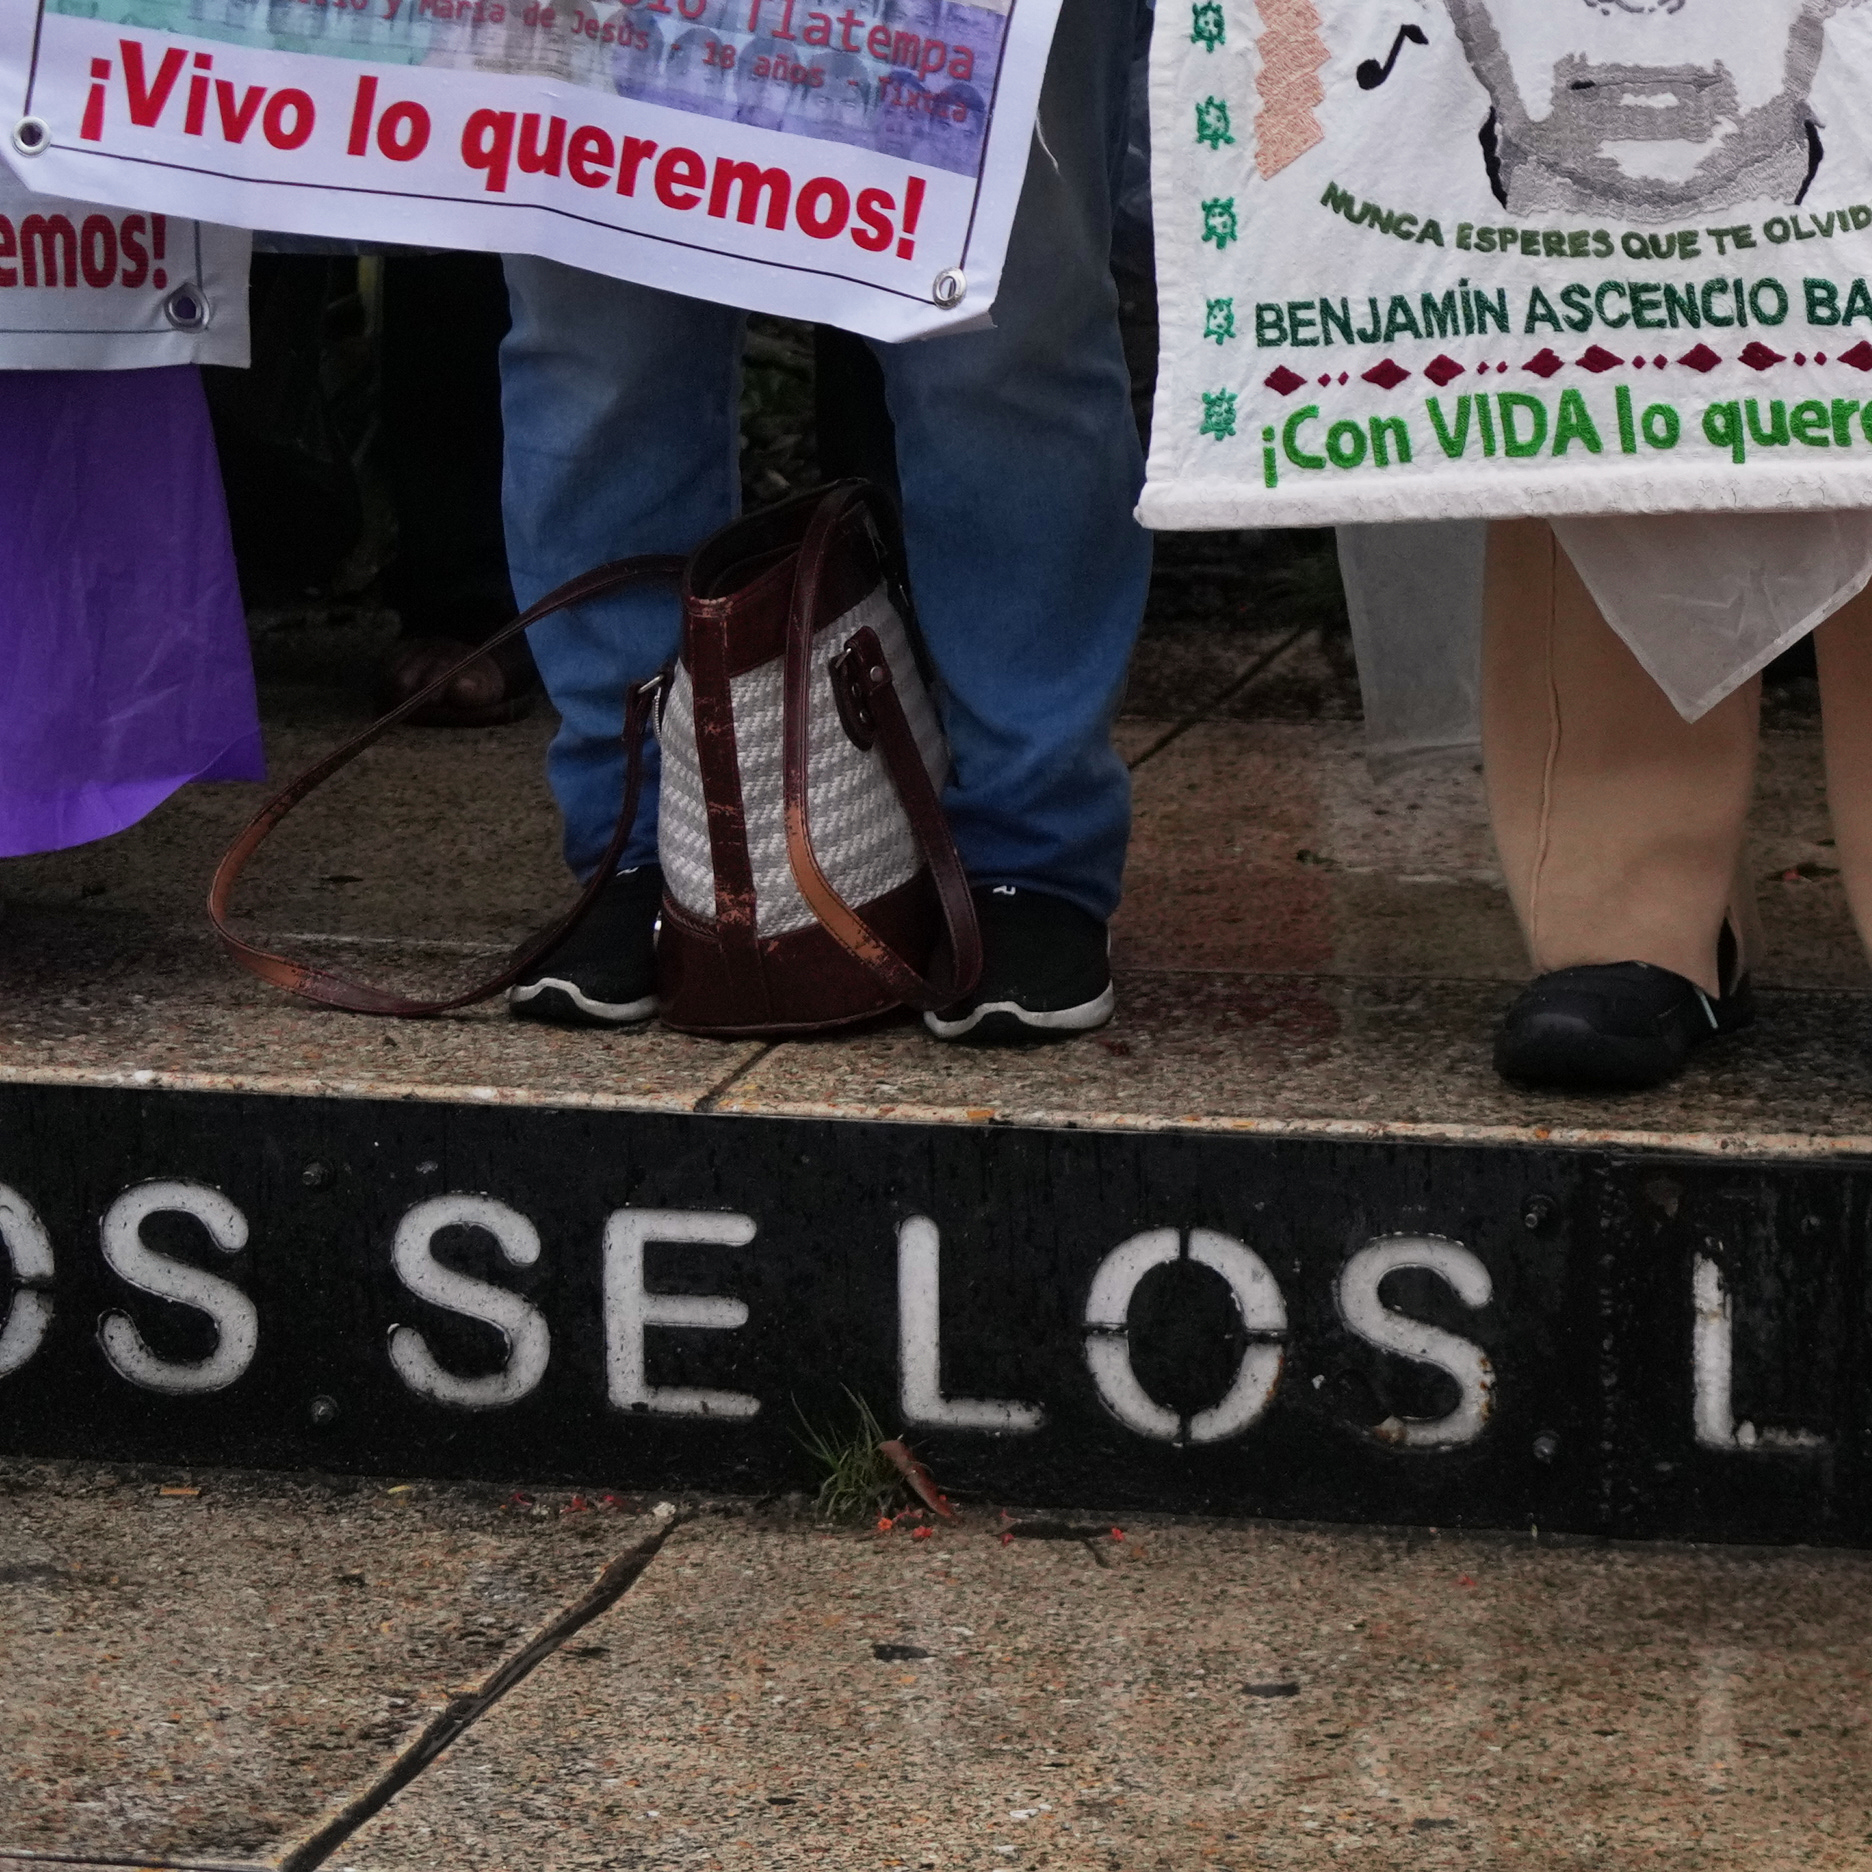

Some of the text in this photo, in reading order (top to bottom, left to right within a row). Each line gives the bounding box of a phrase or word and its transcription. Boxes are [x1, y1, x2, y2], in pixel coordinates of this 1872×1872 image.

[570, 8, 650, 52] Jesús
[702, 39, 736, 70] 18
[753, 51, 825, 88] años
[80, 38, 928, 261] ¡Vivo lo queremos!
[1320, 180, 1445, 248] NUNCA
[1456, 221, 1616, 259] ESPERES
[1621, 228, 1702, 260] QUE
[1706, 224, 1757, 256] TE
[1255, 277, 1510, 347] BENJAMÍN
[1524, 277, 1789, 335] ASCENCIO
[1261, 404, 1413, 488] ¡Con
[1424, 388, 1603, 458] VIDA
[1615, 384, 1682, 455] lo
[388, 1190, 761, 1416] SE
[898, 1214, 1496, 1450] LOS
